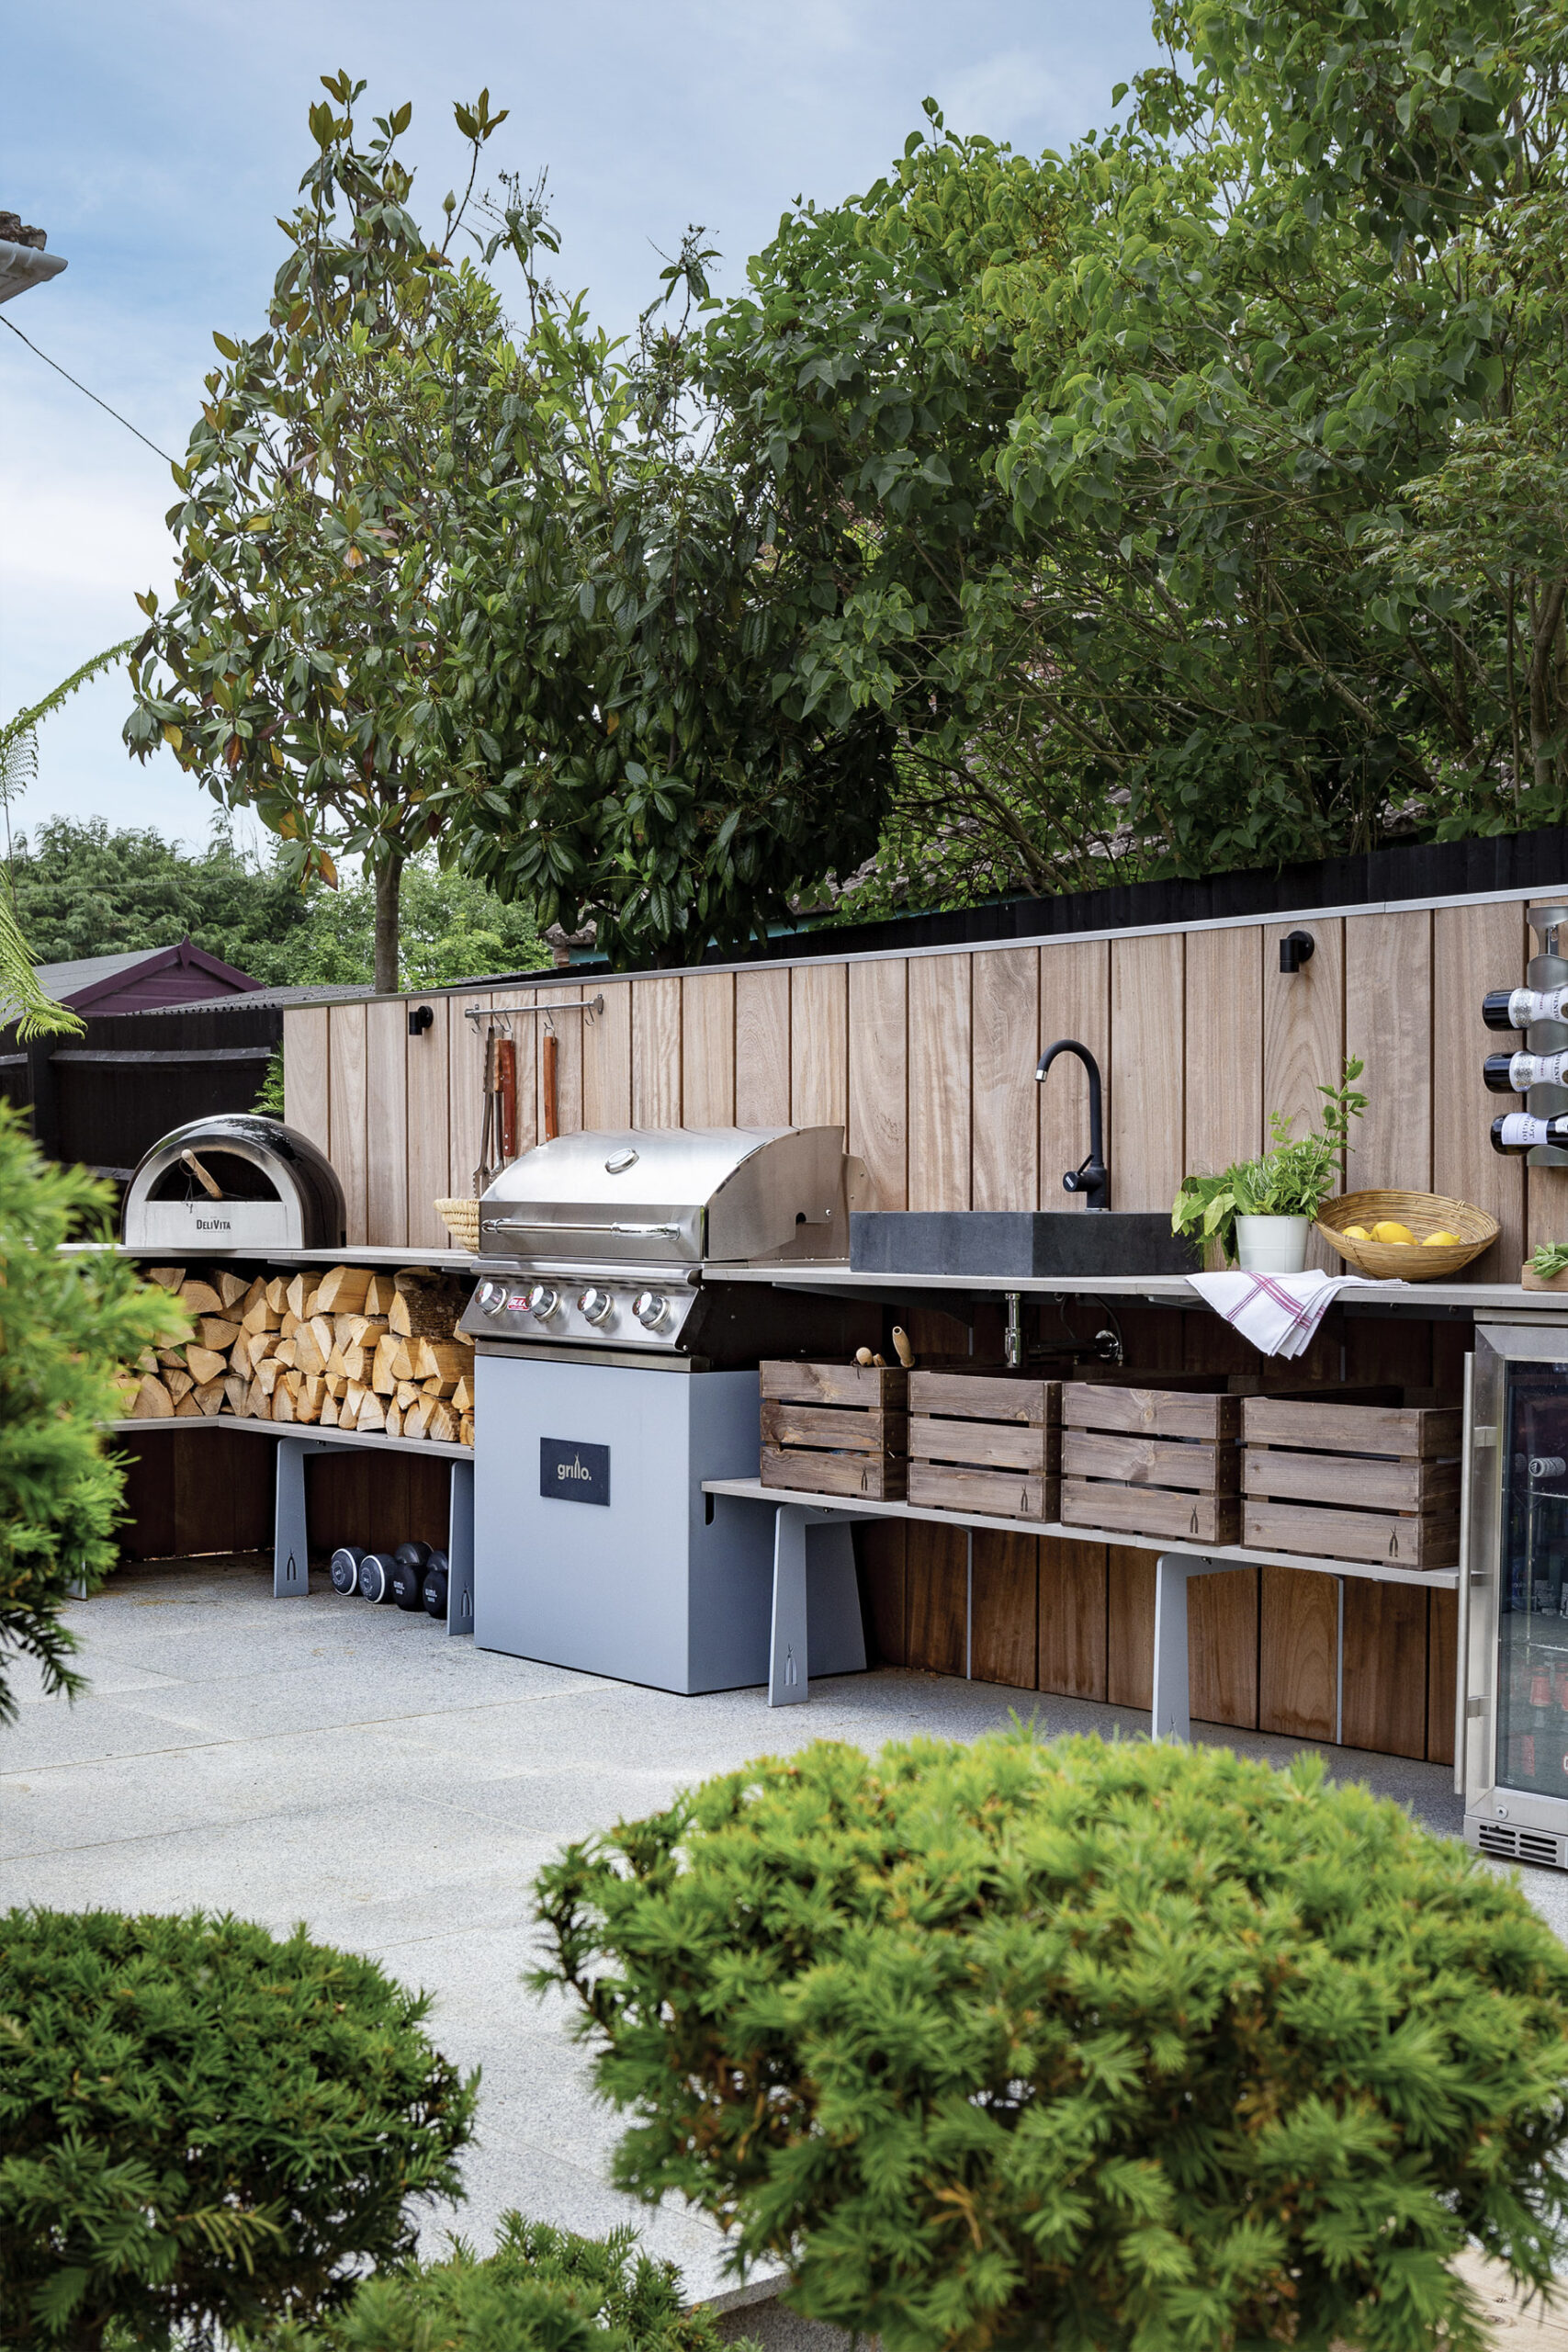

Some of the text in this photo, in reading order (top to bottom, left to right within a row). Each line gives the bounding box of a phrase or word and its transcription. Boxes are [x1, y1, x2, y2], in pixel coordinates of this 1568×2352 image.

[1552, 988, 1563, 1020] RIVENTO
[1553, 1053, 1563, 1085] RIVENTO
[1529, 1117, 1538, 1138] NOT
[197, 1219, 231, 1229] DELIVITA
[558, 1452, 592, 1481] grillo.
